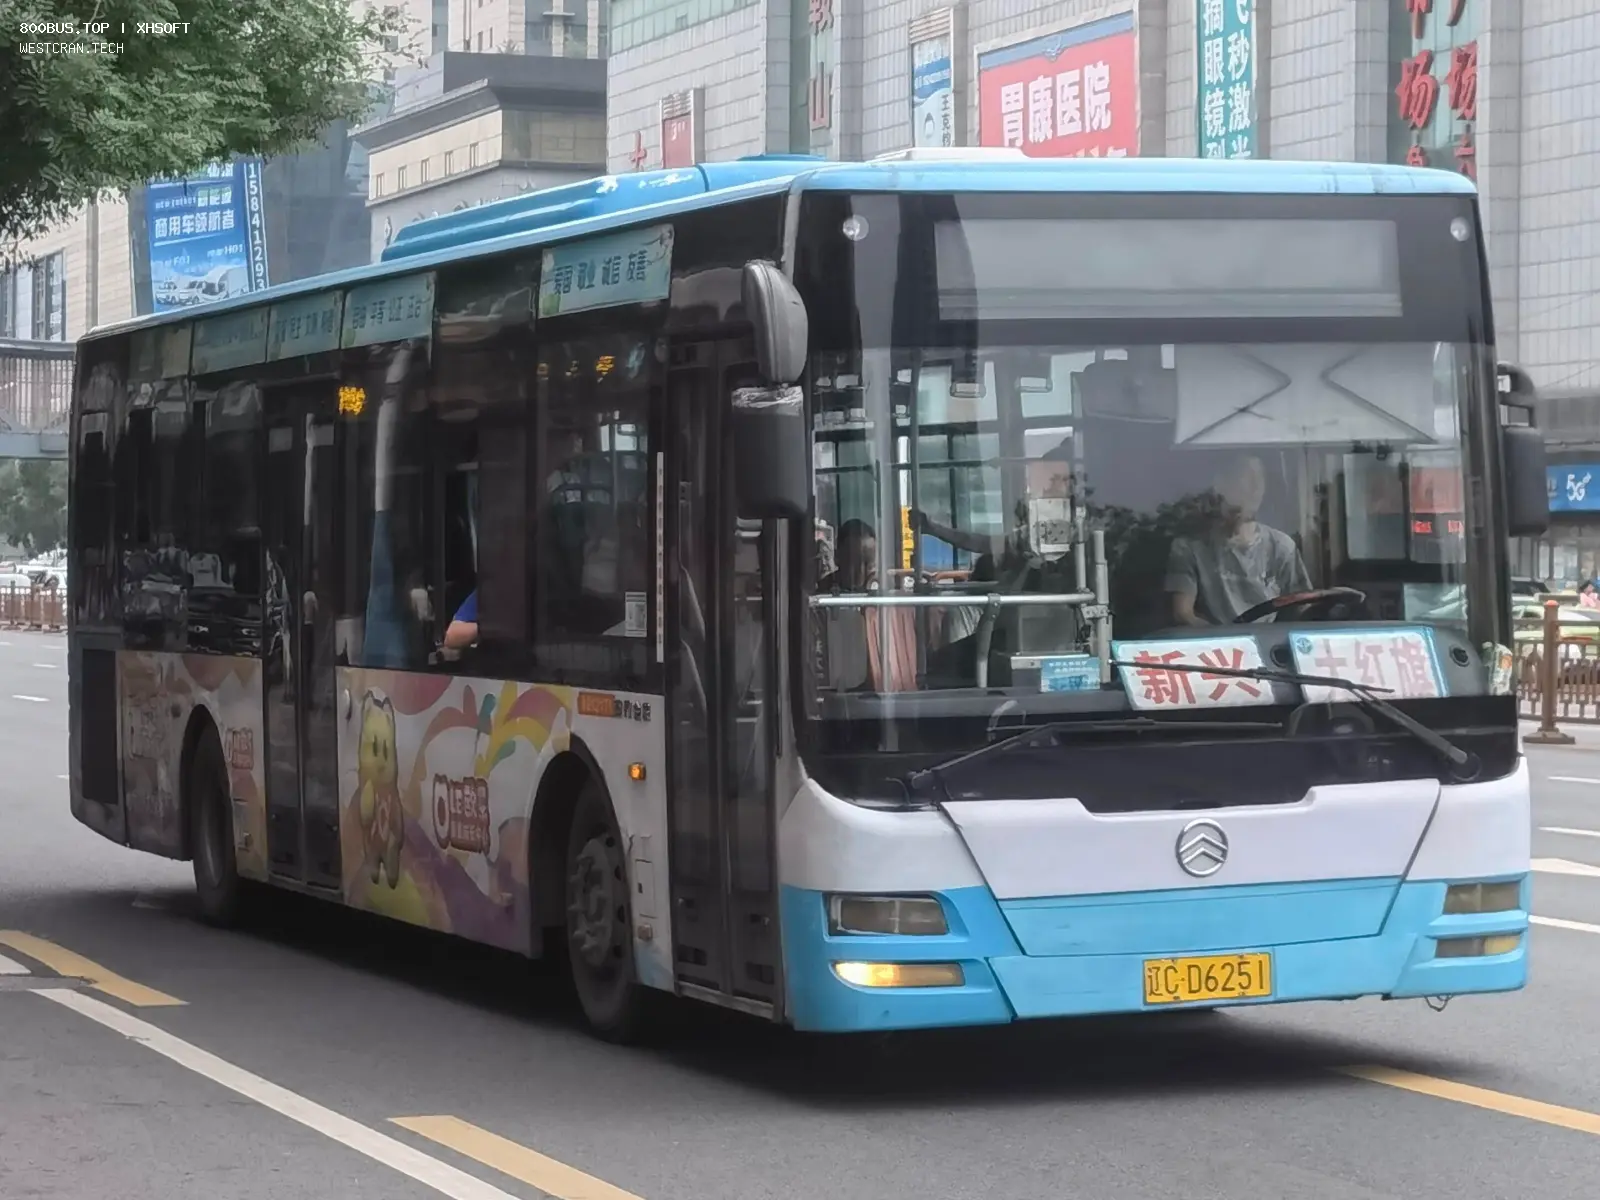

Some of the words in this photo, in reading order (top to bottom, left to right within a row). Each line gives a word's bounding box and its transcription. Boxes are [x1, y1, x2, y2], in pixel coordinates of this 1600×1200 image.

[1001, 60, 1112, 147] 胃康医院
[155, 209, 235, 239] 商用车领航者
[1566, 474, 1586, 501] 5G
[1134, 649, 1262, 704] 新兴
